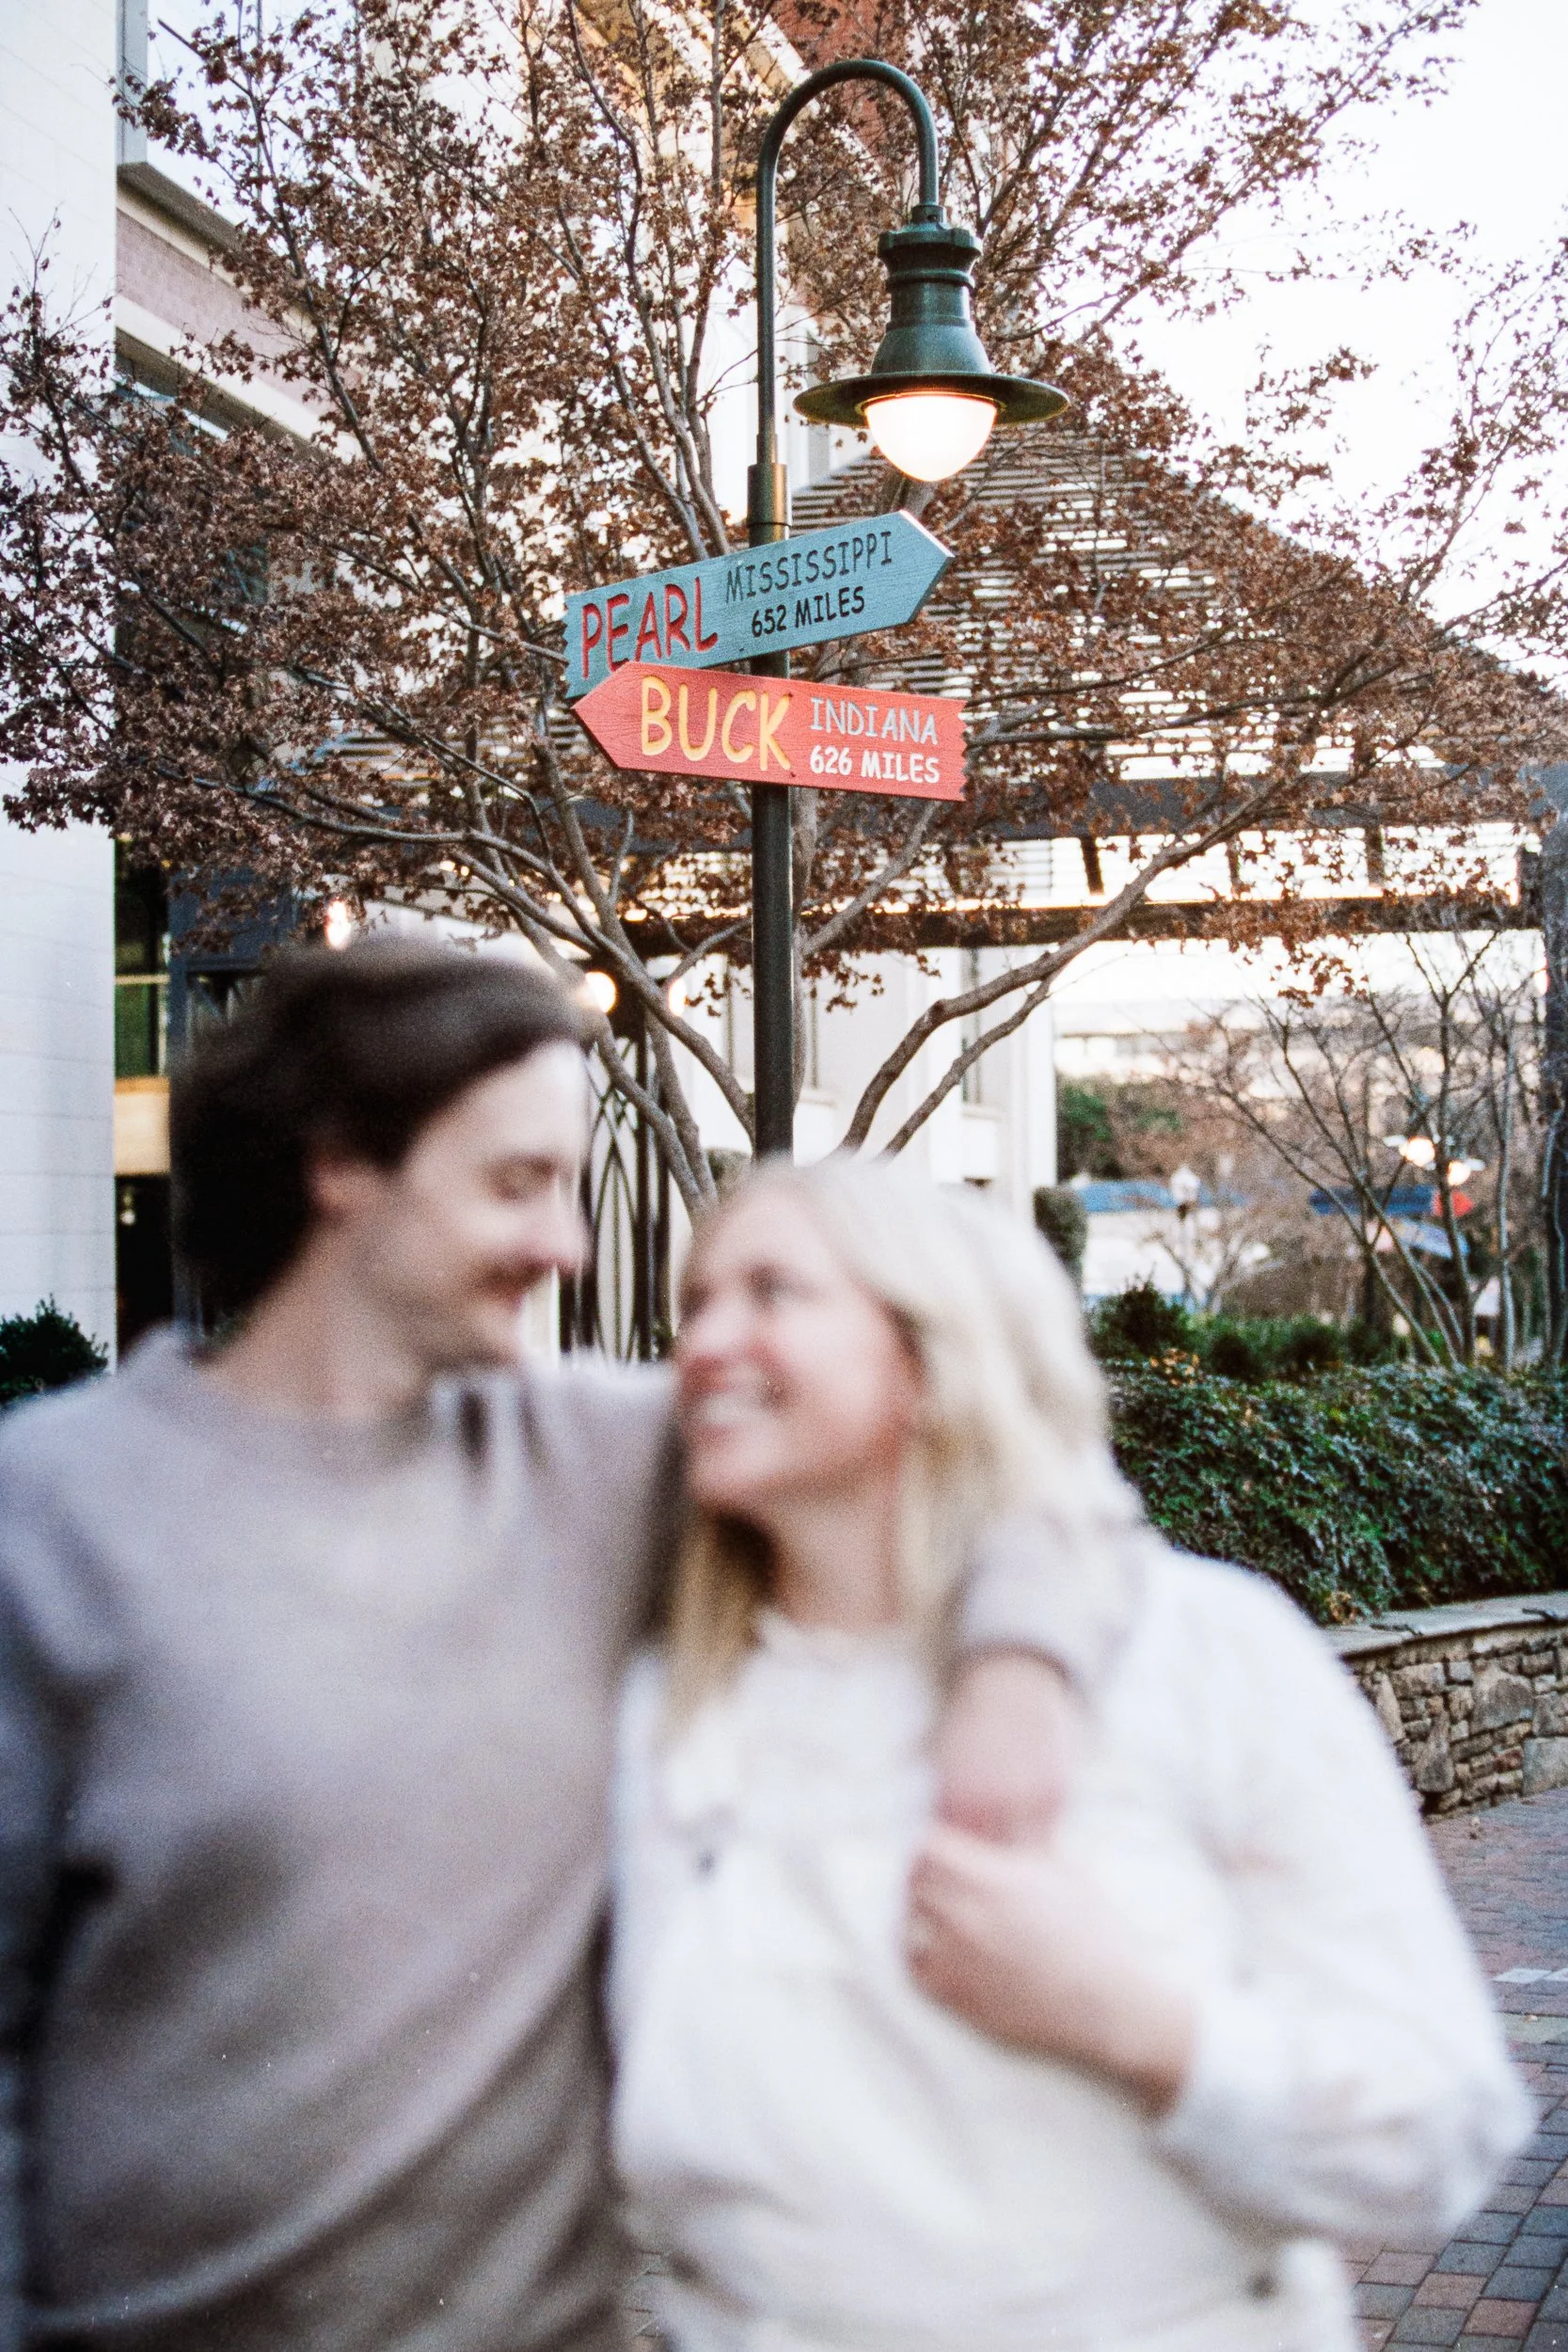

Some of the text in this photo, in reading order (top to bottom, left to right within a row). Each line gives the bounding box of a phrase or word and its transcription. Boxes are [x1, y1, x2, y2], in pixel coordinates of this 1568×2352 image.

[725, 531, 893, 604] MISSISSIPPI
[580, 576, 719, 680] PEARL
[752, 586, 865, 638] 652 MILES
[641, 675, 792, 772] BUCK
[810, 696, 939, 745] INDIANA
[809, 745, 941, 785] 626 MILES
